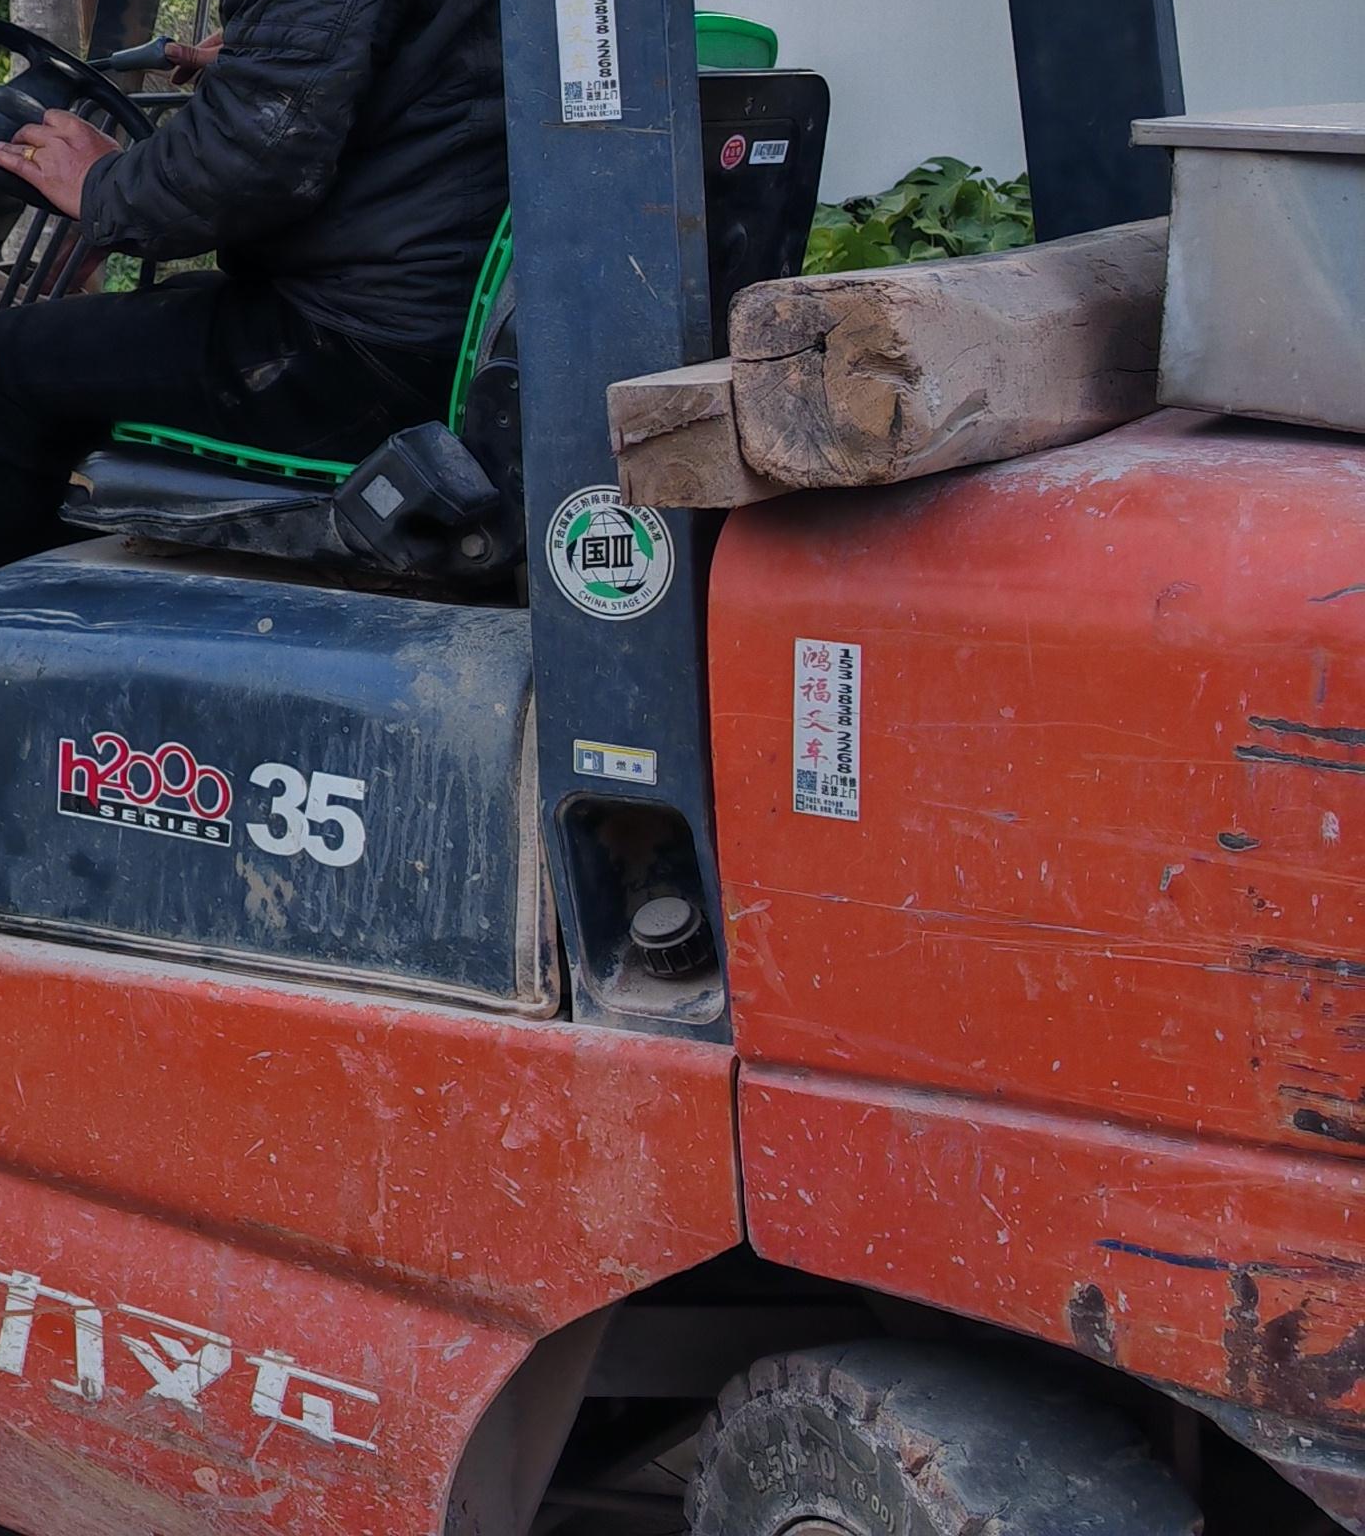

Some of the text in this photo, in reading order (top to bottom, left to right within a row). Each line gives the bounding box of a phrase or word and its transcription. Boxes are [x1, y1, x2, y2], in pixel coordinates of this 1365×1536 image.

[578, 587, 653, 611] CHINA STAGE III
[800, 645, 835, 769] 鸿福叉车
[58, 732, 233, 821] h2000
[246, 762, 366, 868] 35
[99, 804, 223, 840] SERIES
